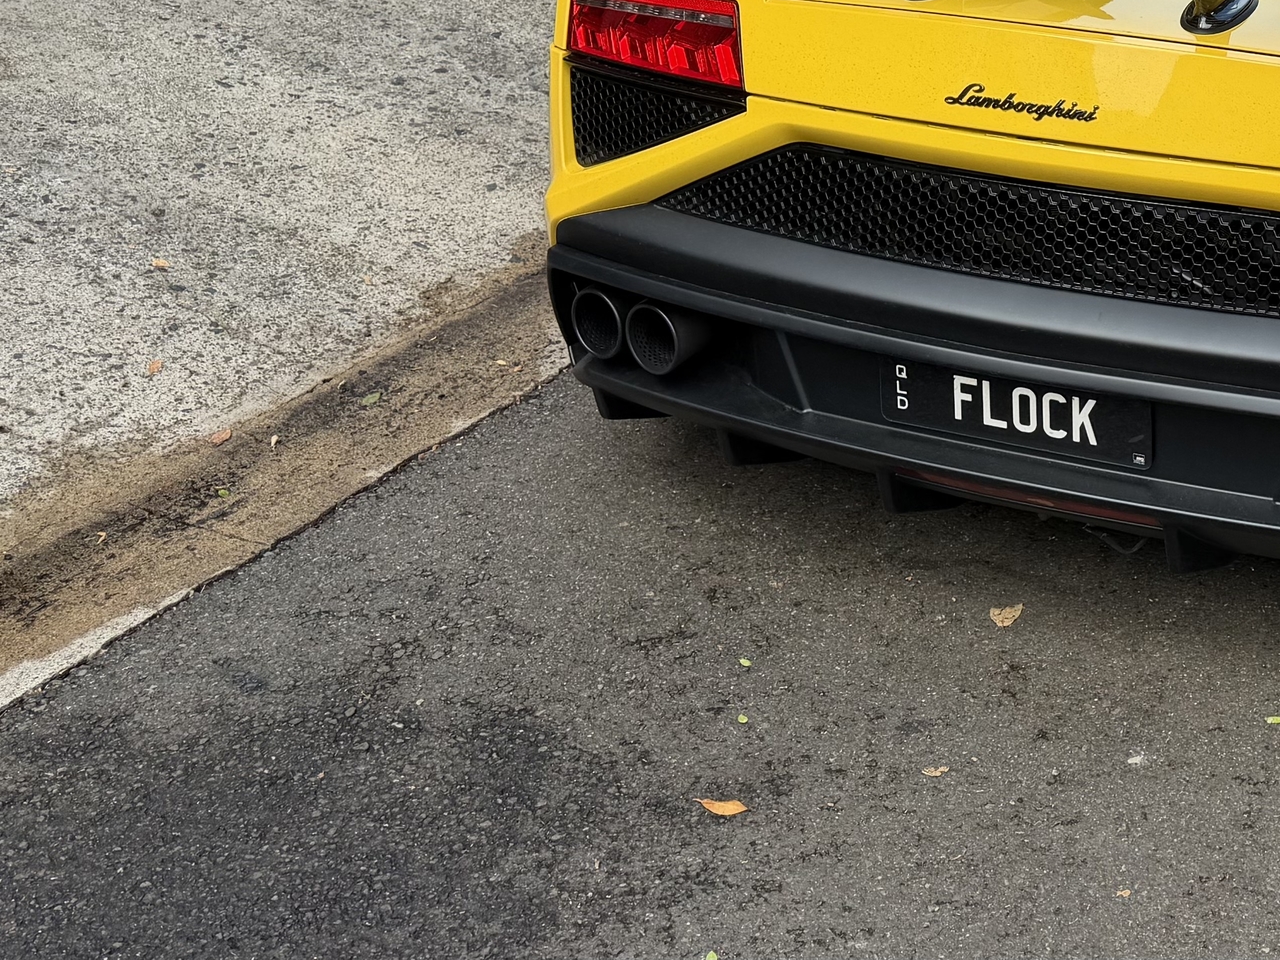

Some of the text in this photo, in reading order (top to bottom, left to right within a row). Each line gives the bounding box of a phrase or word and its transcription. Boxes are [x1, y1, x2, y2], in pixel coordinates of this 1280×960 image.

[944, 83, 1099, 122] Lamborghini
[895, 364, 909, 410] QLD
[953, 374, 1098, 446] FLOCK
